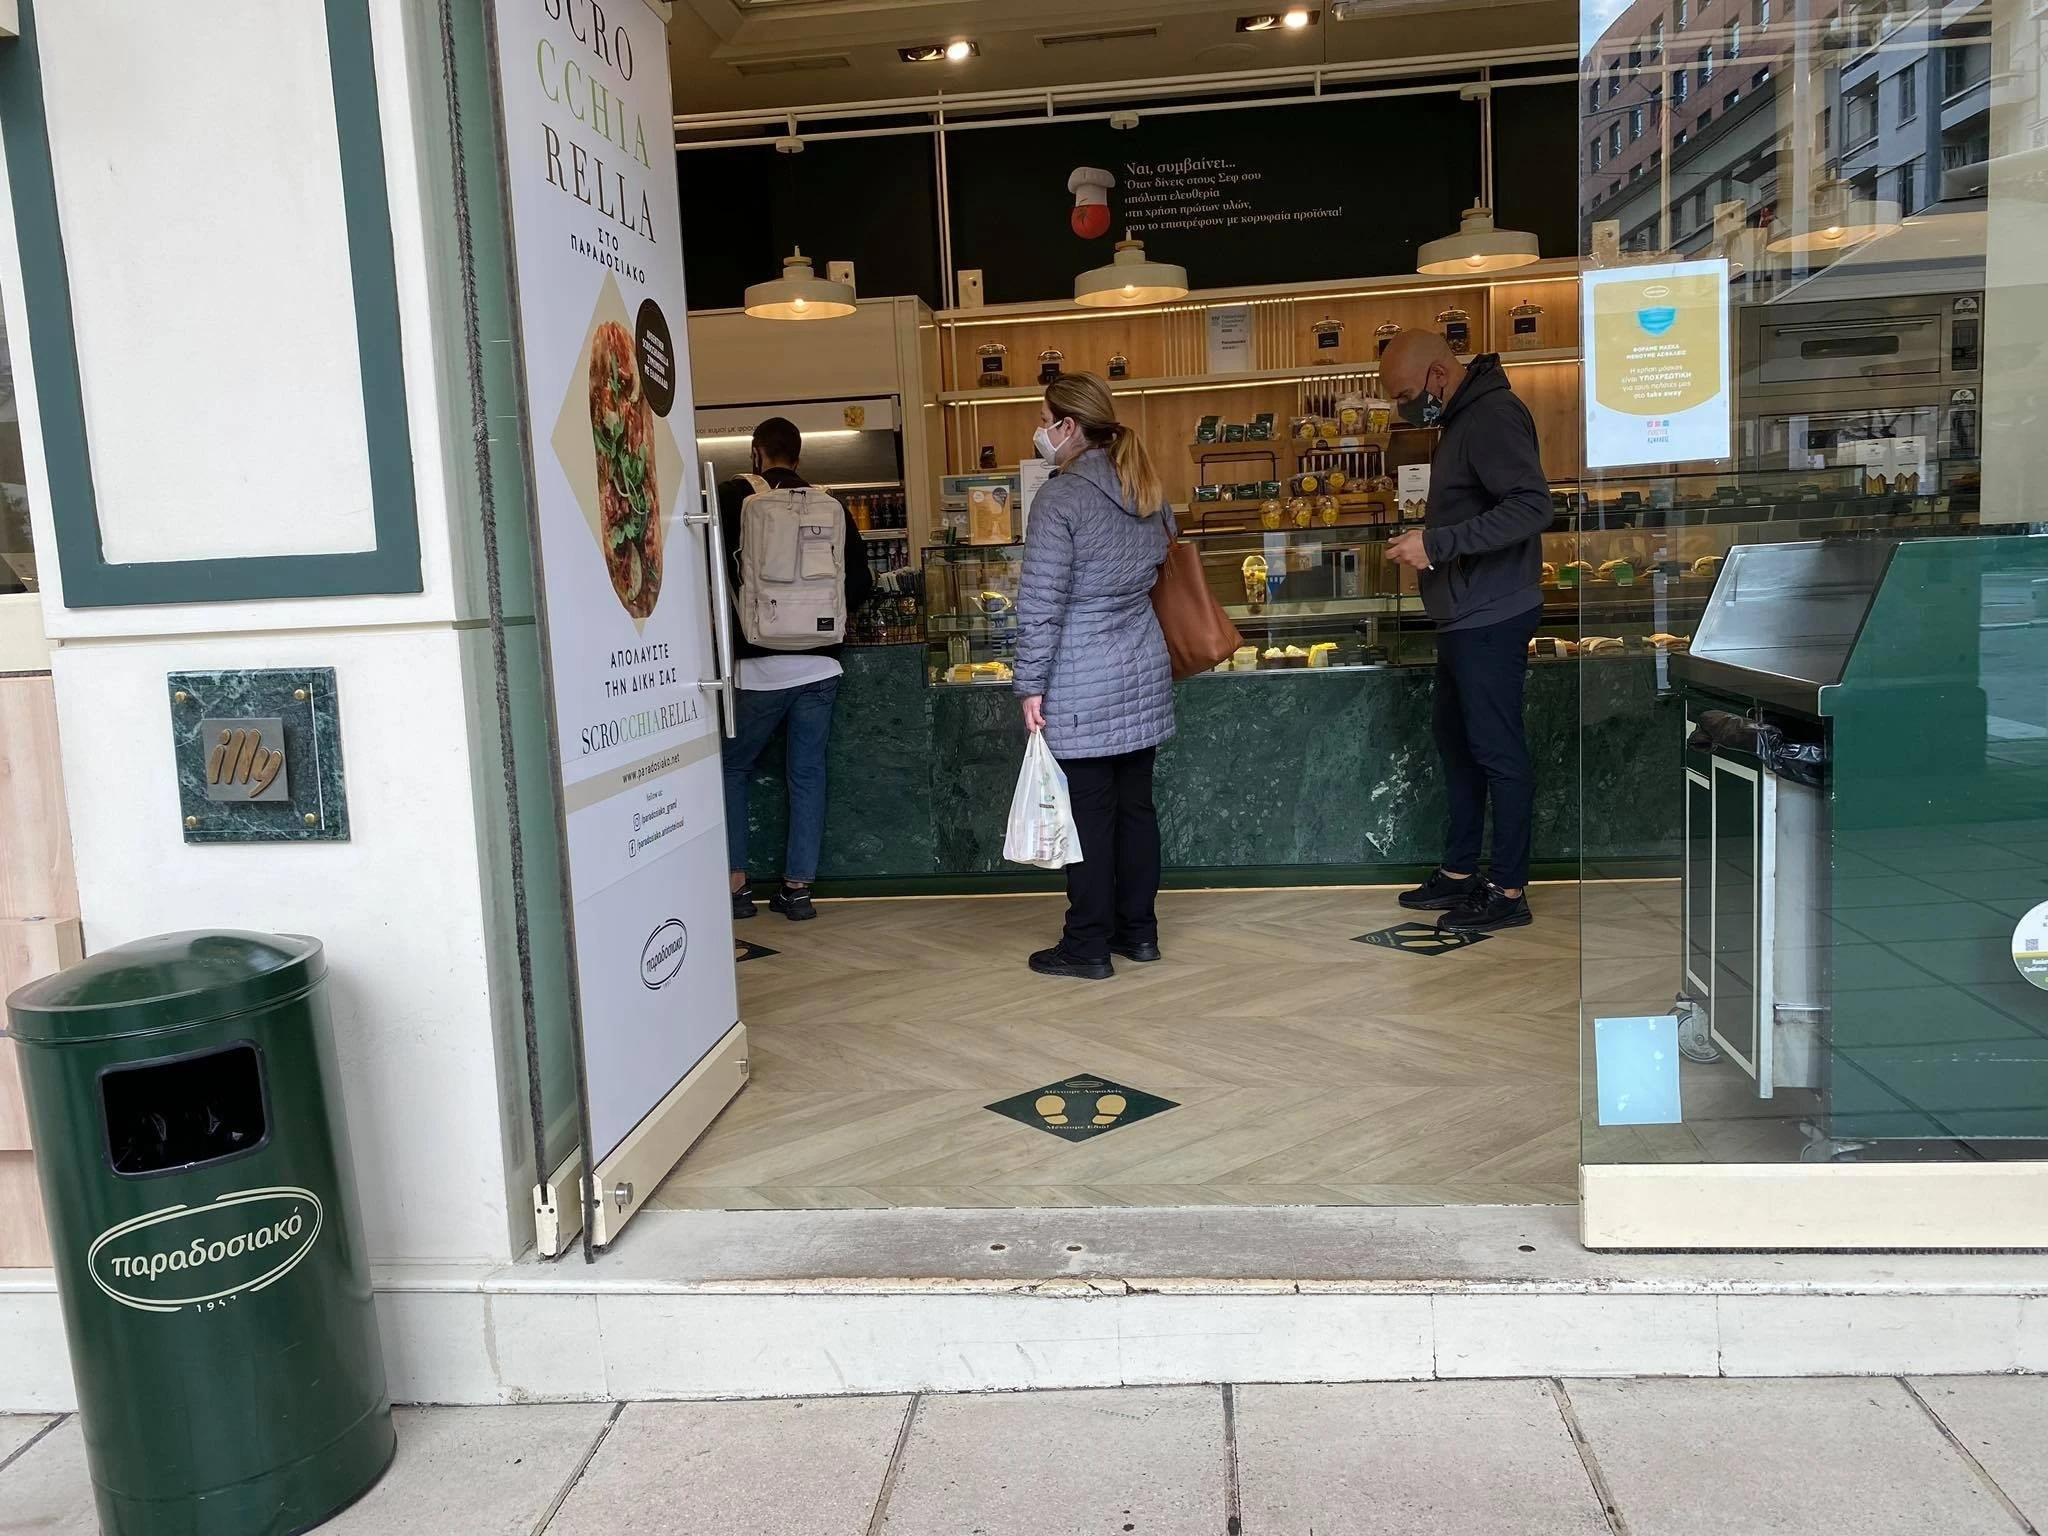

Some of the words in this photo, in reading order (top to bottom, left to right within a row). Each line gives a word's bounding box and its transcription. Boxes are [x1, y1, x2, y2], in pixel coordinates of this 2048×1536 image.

[537, 38, 651, 170] CCHIA
[541, 122, 657, 243] RELLA
[1155, 177, 1184, 187] δίνεις
[1186, 175, 1215, 185] στους
[1218, 172, 1239, 184] Σεφ
[1242, 172, 1261, 180] σου
[1169, 188, 1220, 200] ελευθερία
[1145, 206, 1177, 218] χρήση
[1180, 204, 1220, 215] πρώτων
[1223, 199, 1252, 210] υλών,
[1160, 217, 1223, 229] επιστρέφουν
[1227, 217, 1238, 226] με
[1241, 211, 1291, 224] κορυφαία
[1293, 206, 1343, 221] προϊόντα!
[598, 227, 619, 251] ΣΤΟ
[570, 233, 645, 284] ΠΑΡΑΔΟΣΙΑΚΟ
[1639, 372, 1692, 381] ΥΠΟΧΡΕΩΤΙΚΗ
[610, 643, 669, 668] ΑΠΟΛΑΥΣΤΕ
[604, 678, 627, 698] ΤΗΝ
[632, 673, 655, 692] ΔΙΚΗ
[660, 667, 677, 686] ΣΑΣ
[581, 698, 699, 755] SCROCCHIARELLA
[208, 728, 282, 798] illy
[622, 753, 680, 783] www.paradosiako.net
[111, 1206, 302, 1281] παραδοσιακό
